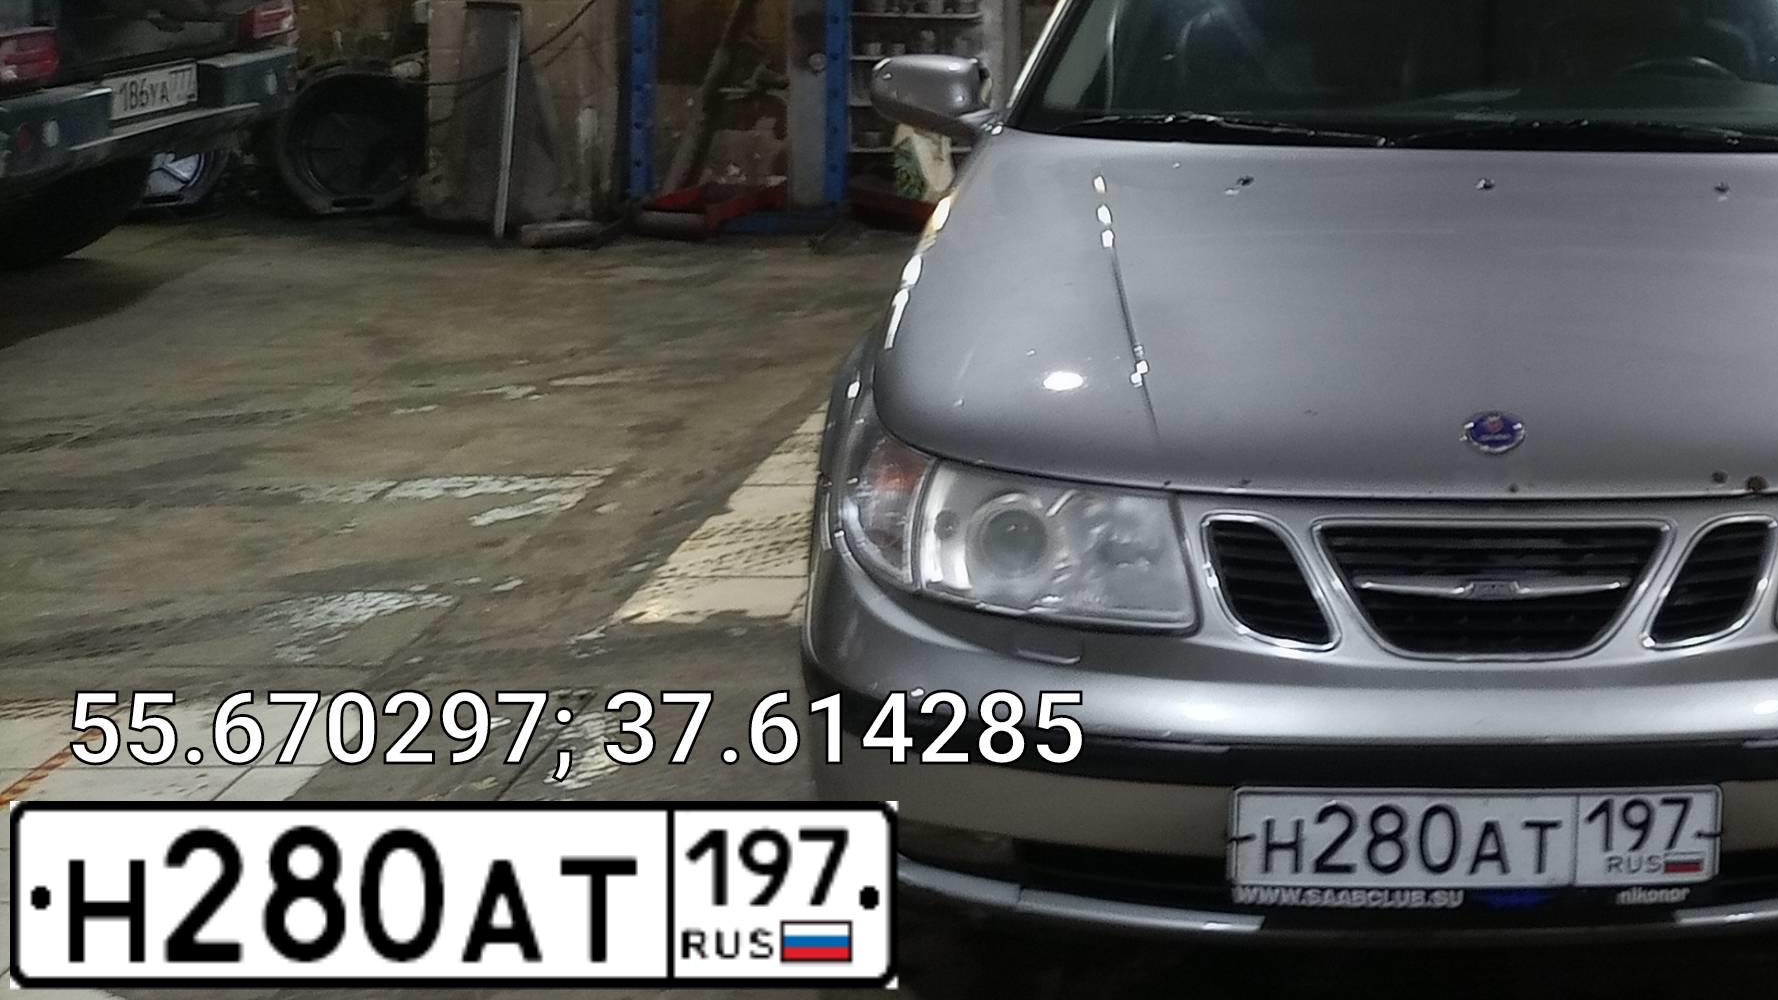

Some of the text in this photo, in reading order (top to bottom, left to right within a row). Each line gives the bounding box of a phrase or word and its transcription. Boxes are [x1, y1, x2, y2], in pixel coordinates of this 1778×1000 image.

[1260, 796, 1694, 876] H280AT 197
[1606, 854, 1663, 875] RUS
[1233, 885, 1465, 909] WWW.SAABCLUB.SU
